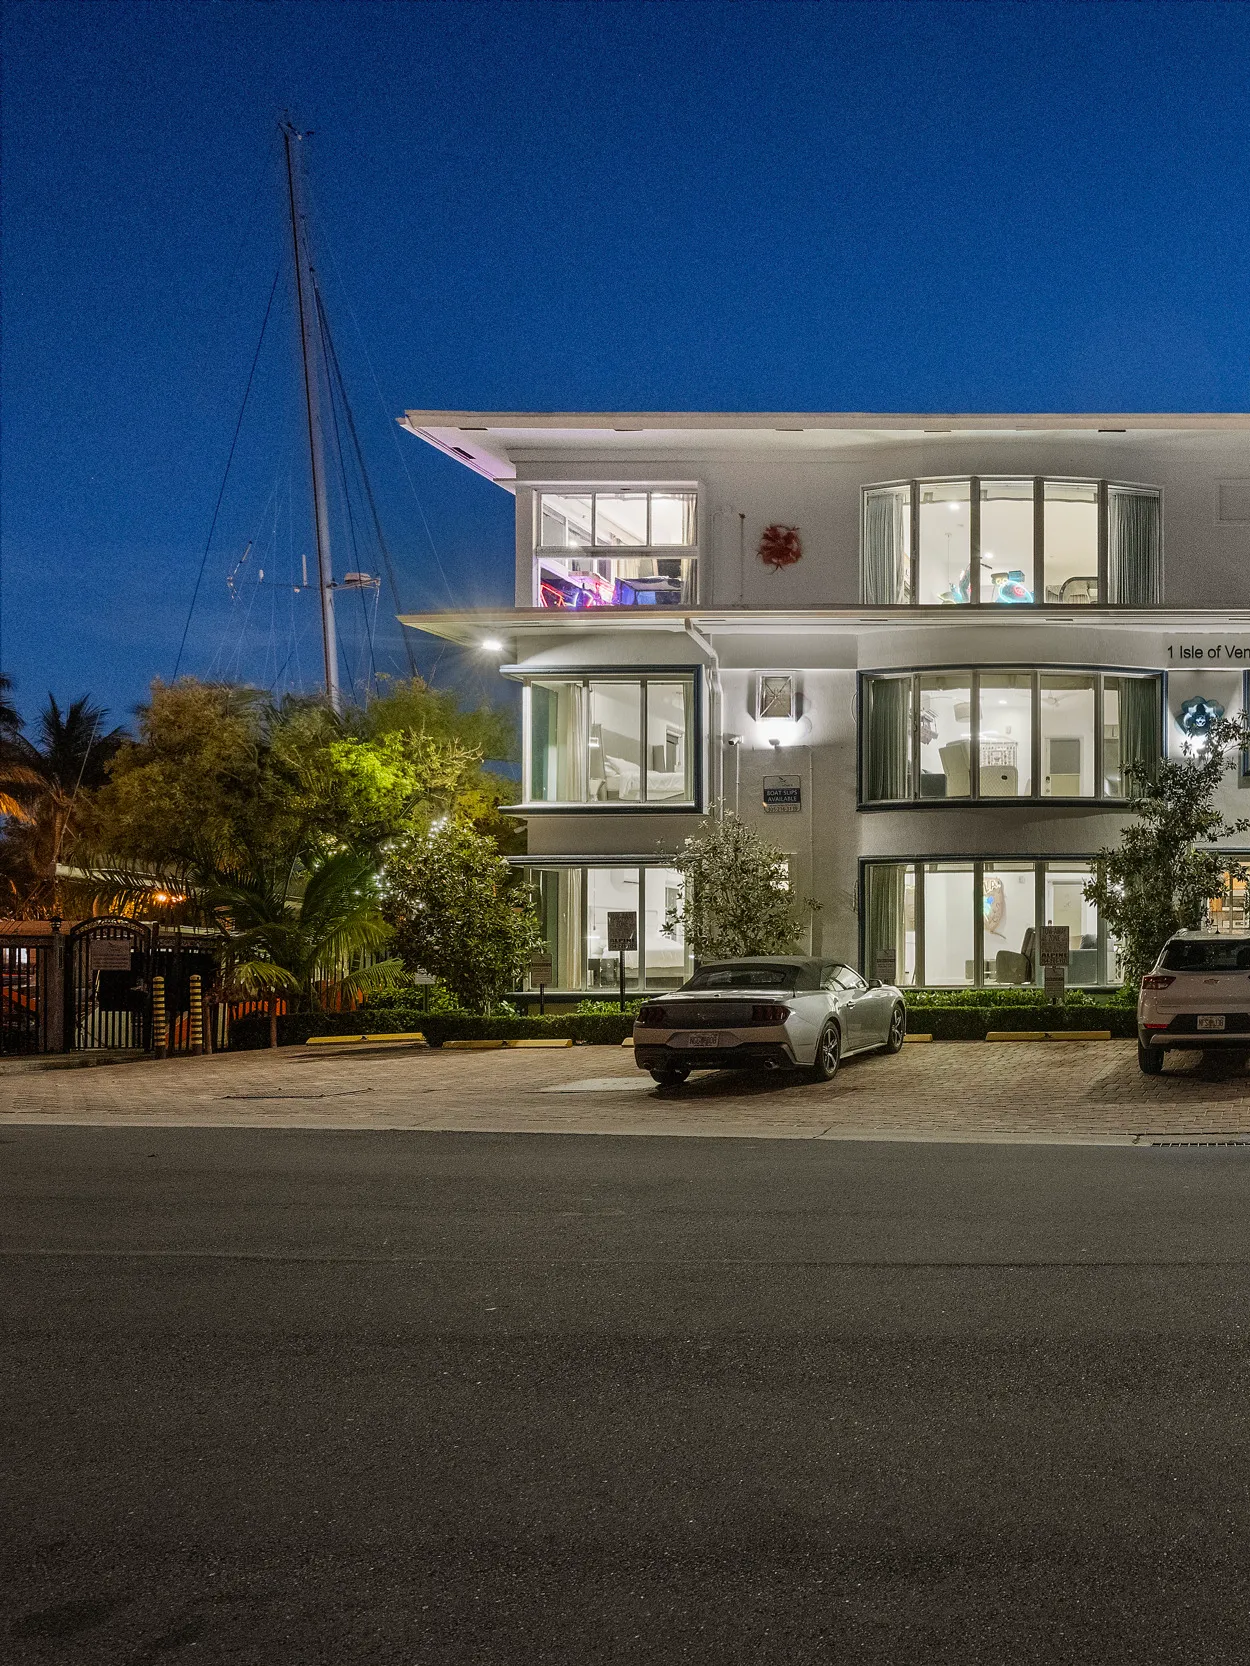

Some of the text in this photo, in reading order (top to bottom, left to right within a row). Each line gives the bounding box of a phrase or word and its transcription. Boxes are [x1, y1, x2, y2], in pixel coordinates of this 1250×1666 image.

[1167, 645, 1173, 658] 1
[1180, 645, 1203, 659] Isle
[1207, 645, 1221, 659] of
